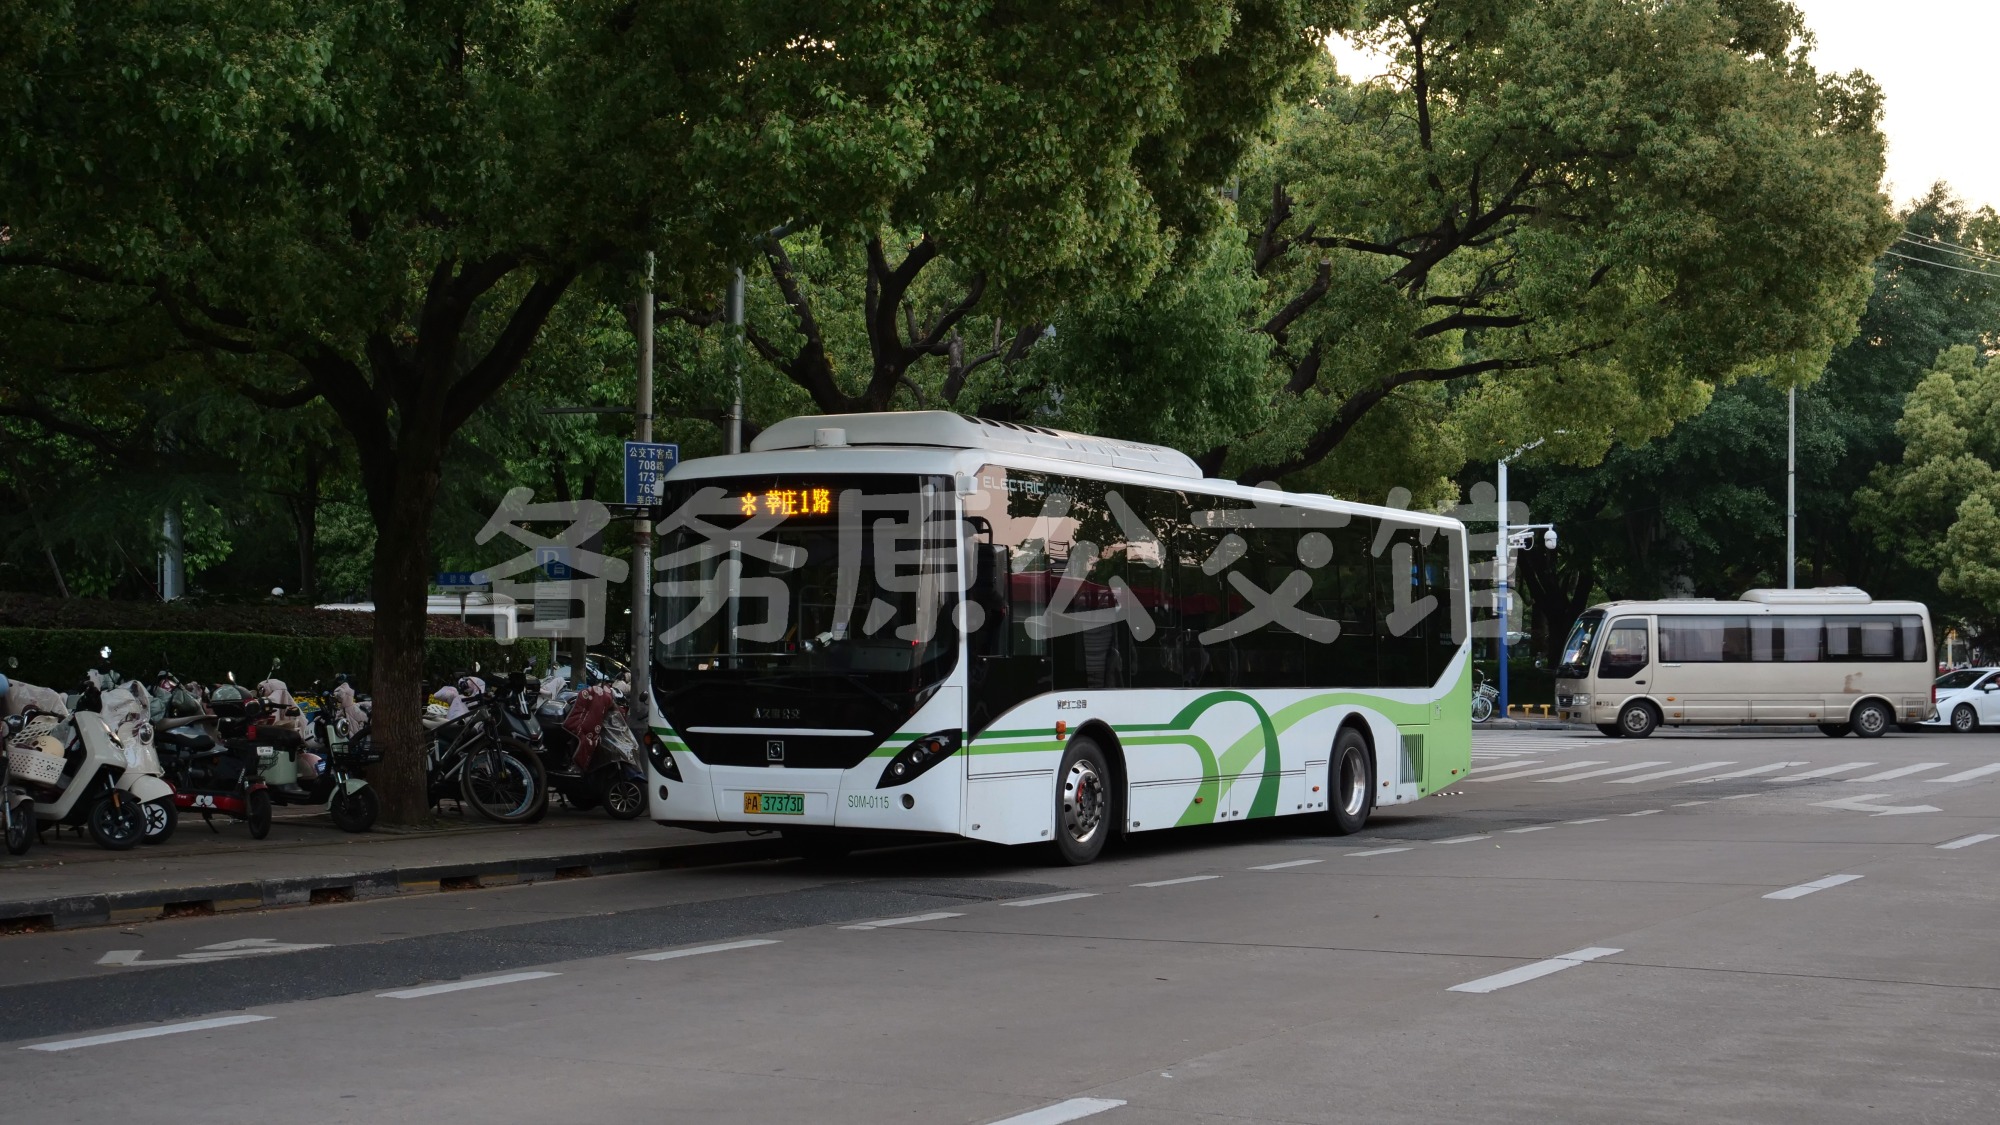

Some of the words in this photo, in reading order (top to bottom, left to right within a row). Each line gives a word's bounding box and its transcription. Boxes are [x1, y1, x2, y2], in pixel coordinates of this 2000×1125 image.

[629, 446, 674, 460] 公交下客点
[638, 460, 664, 471] 708路
[983, 475, 1045, 495] ELECTRIC
[765, 488, 830, 515] 莘庄1路
[542, 550, 560, 576] P
